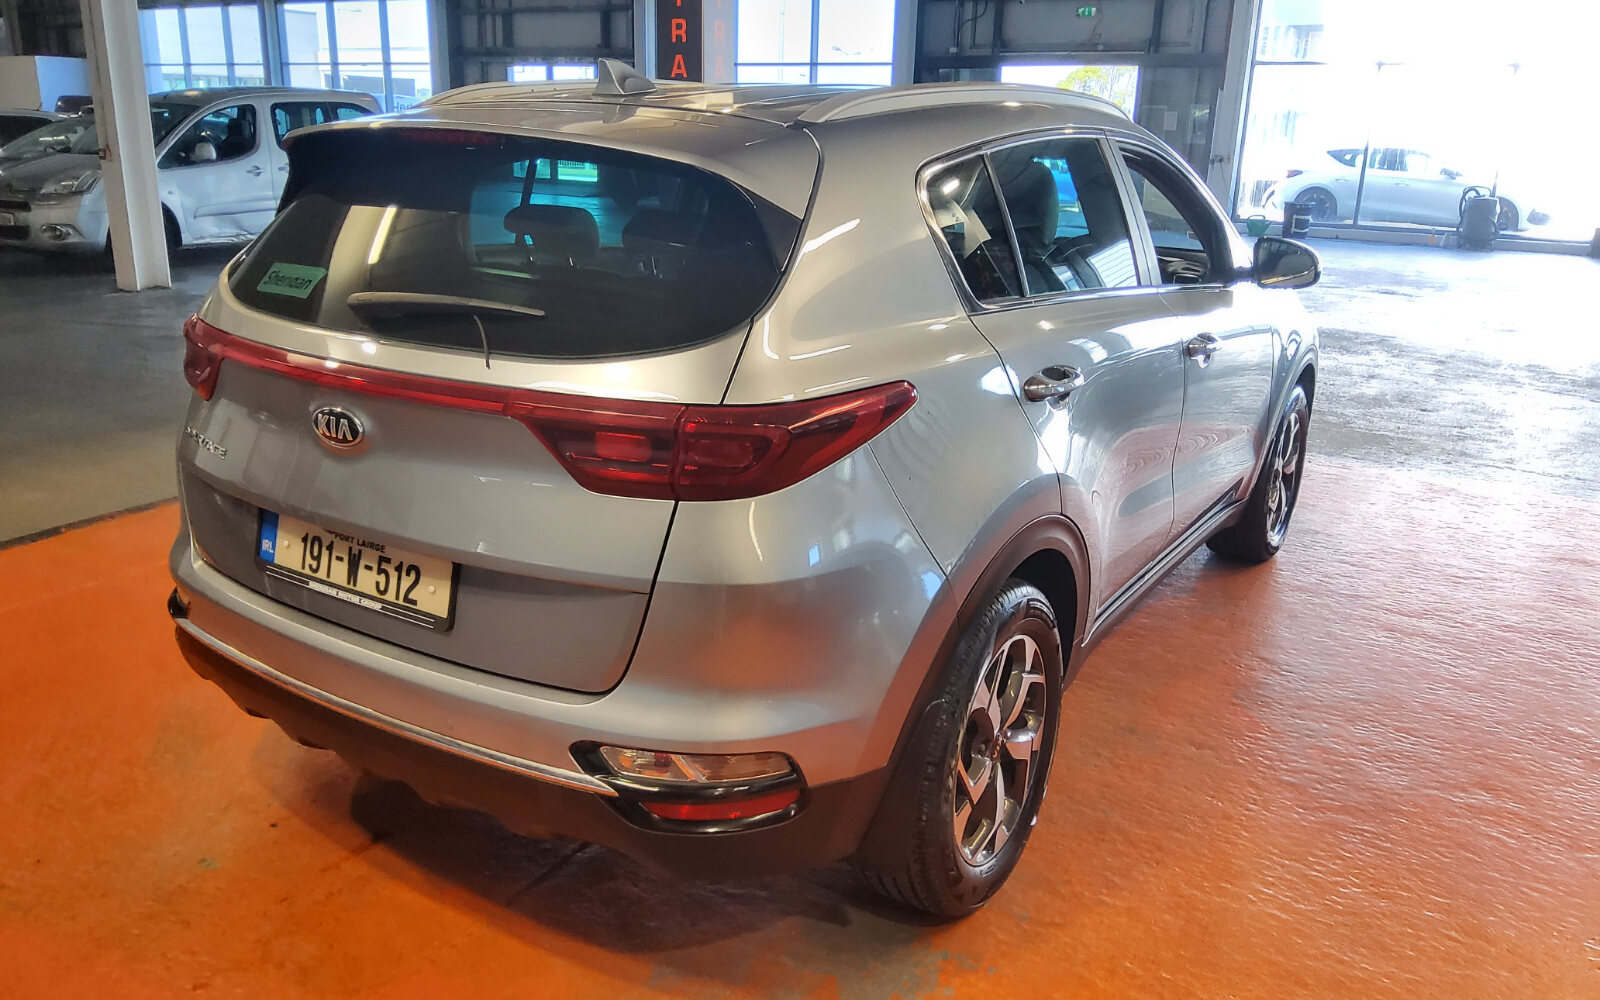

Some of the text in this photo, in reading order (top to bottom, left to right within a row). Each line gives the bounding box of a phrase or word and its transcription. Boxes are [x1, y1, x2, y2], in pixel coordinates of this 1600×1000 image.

[317, 413, 353, 441] KIA
[261, 538, 275, 554] IRL
[301, 531, 422, 607] 191-W-512
